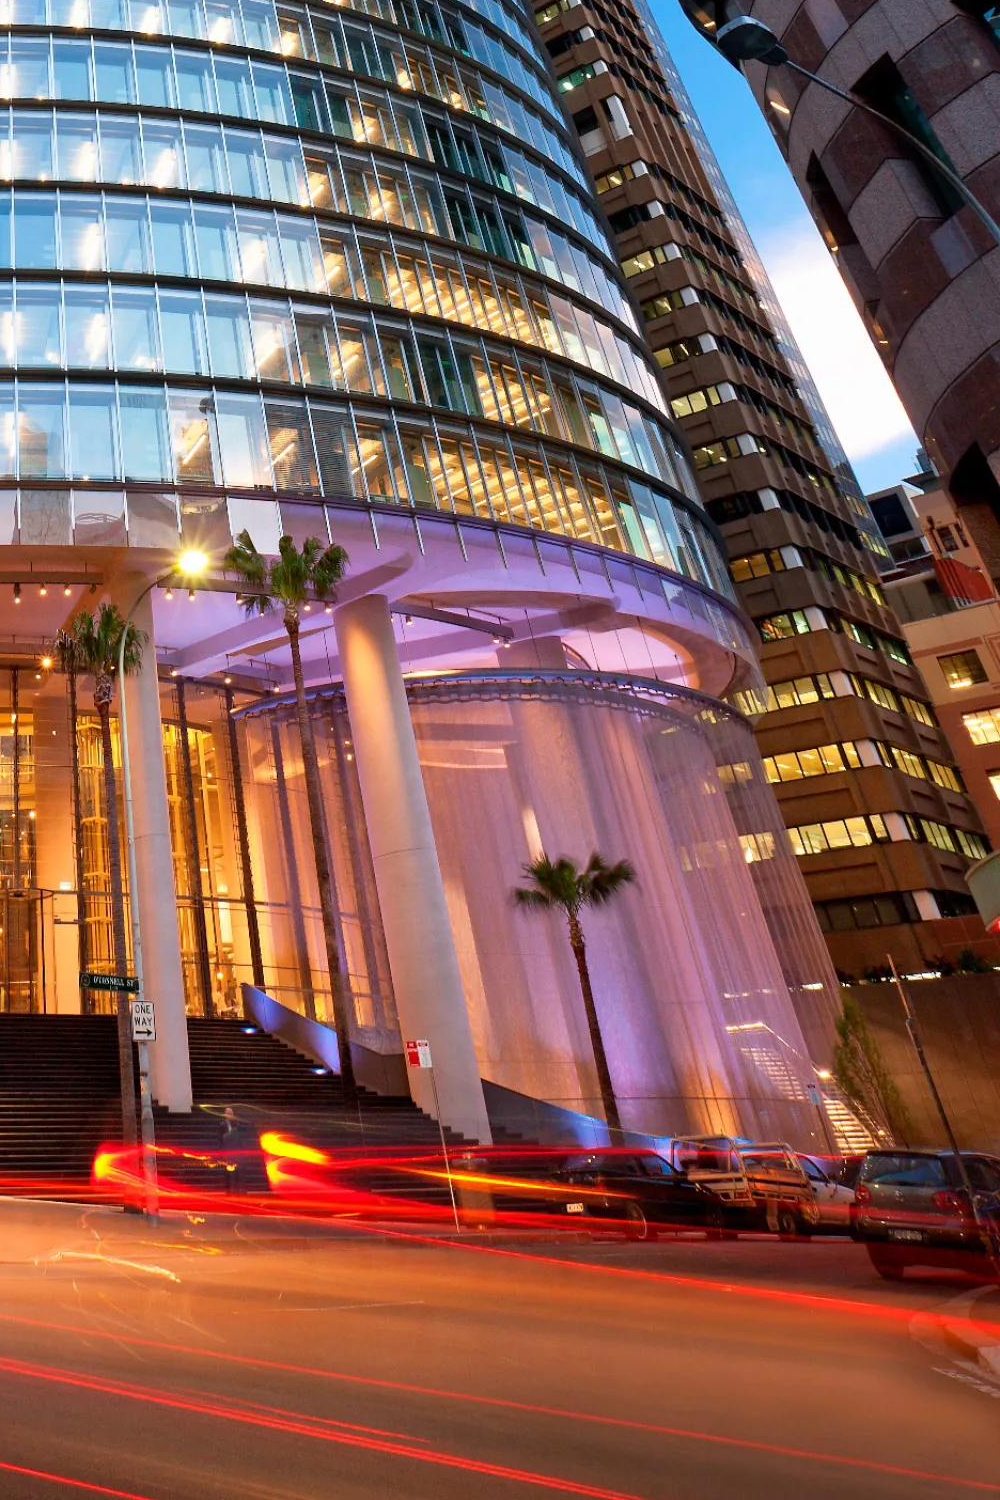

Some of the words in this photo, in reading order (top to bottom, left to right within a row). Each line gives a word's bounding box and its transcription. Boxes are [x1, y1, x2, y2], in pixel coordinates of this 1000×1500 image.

[126, 979, 134, 987] ST
[135, 1004, 151, 1014] ONE
[134, 1016, 152, 1026] WAY
